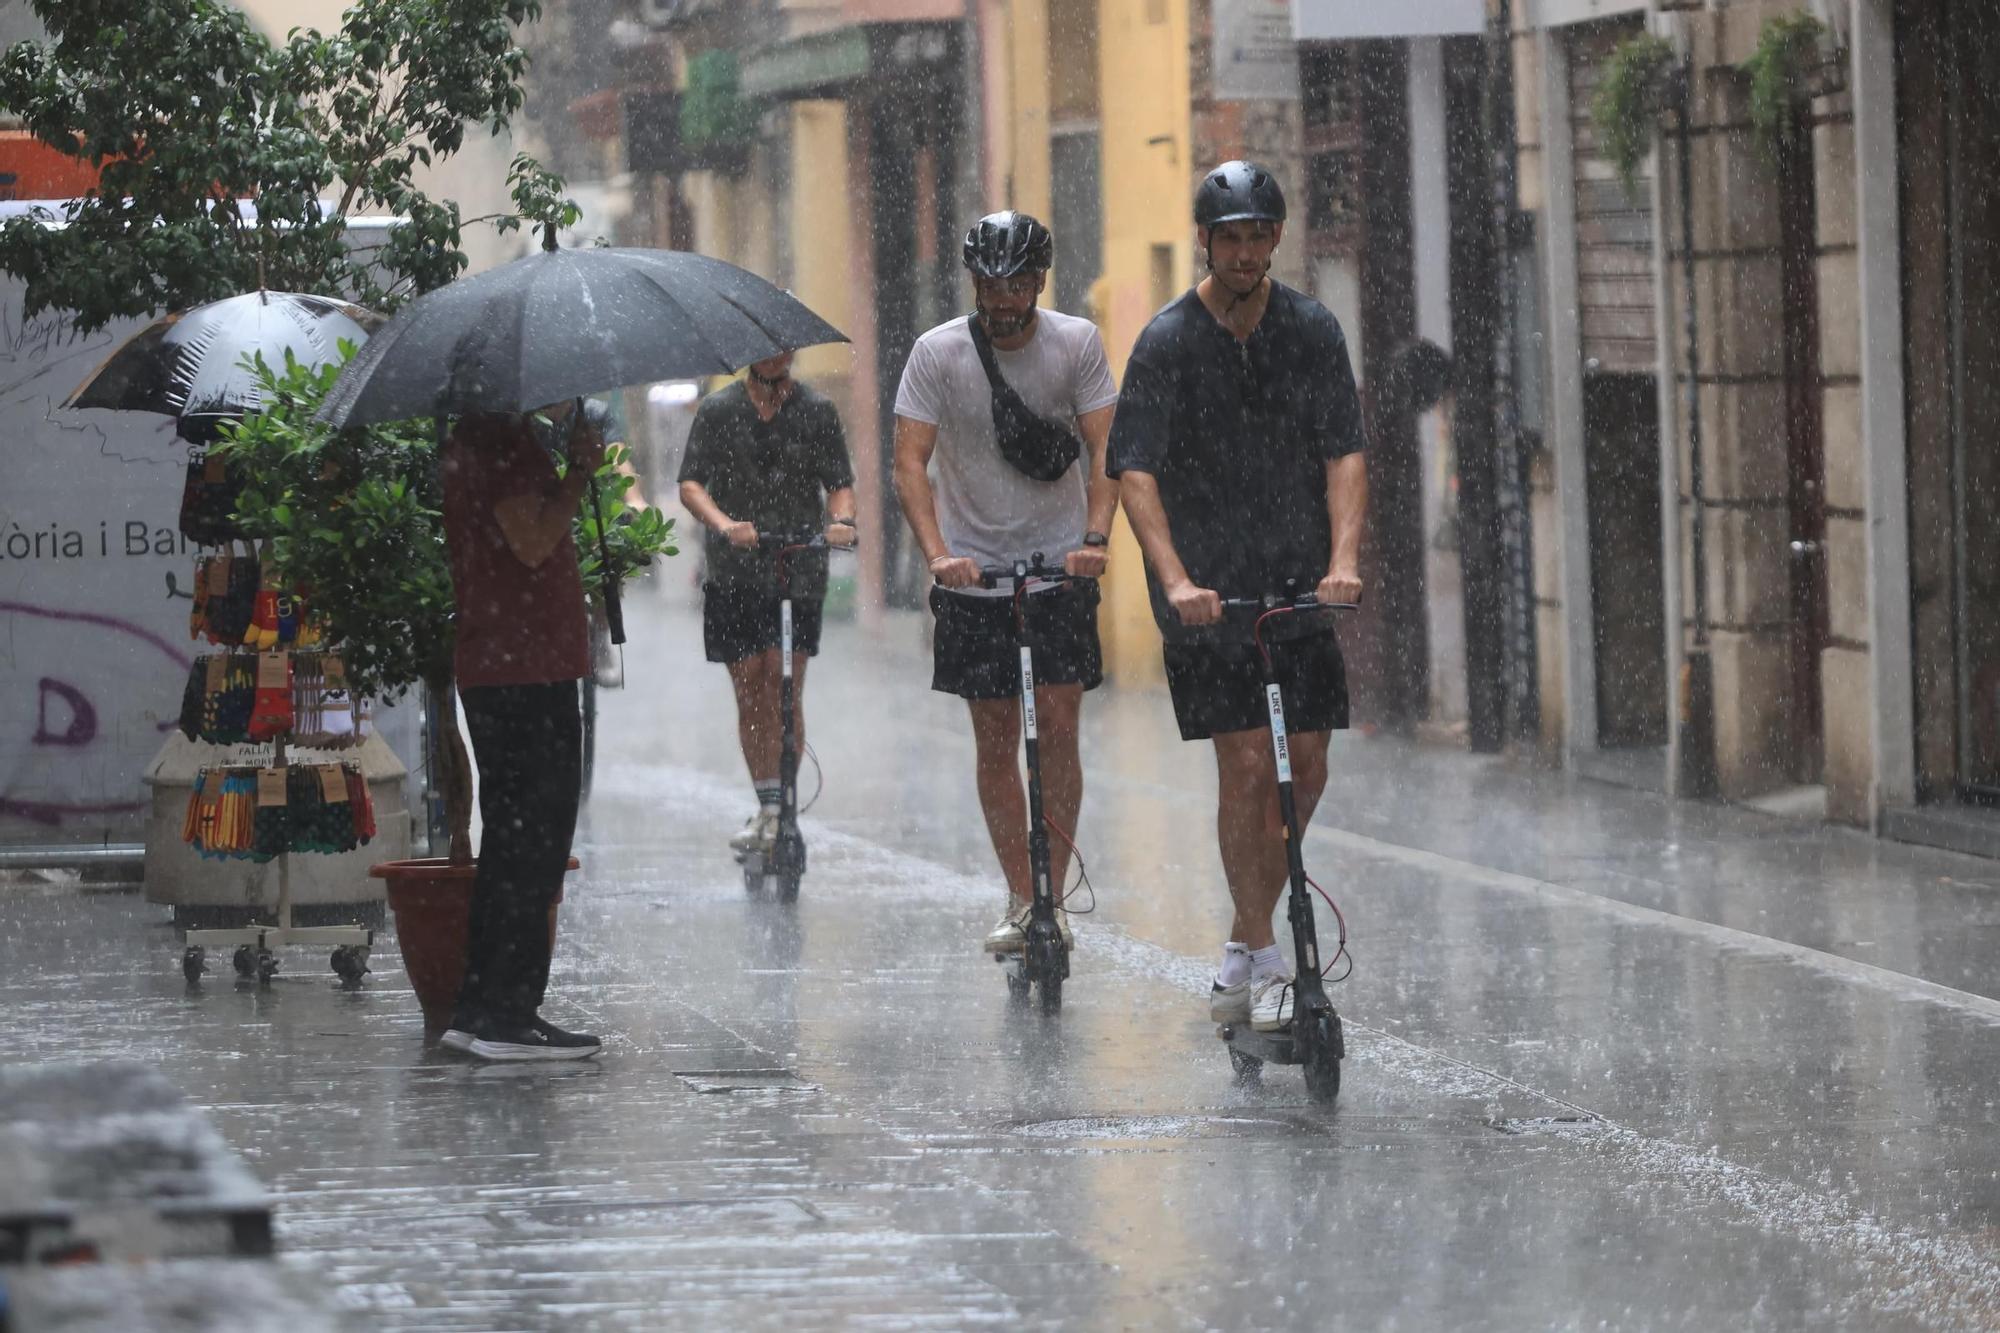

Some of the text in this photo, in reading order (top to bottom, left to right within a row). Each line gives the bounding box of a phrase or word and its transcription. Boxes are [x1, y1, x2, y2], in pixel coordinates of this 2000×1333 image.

[0, 522, 83, 559] òria
[101, 521, 107, 556] i
[1024, 670, 1035, 727] LIKE BIKE
[1271, 691, 1287, 760] LIKE BIKE
